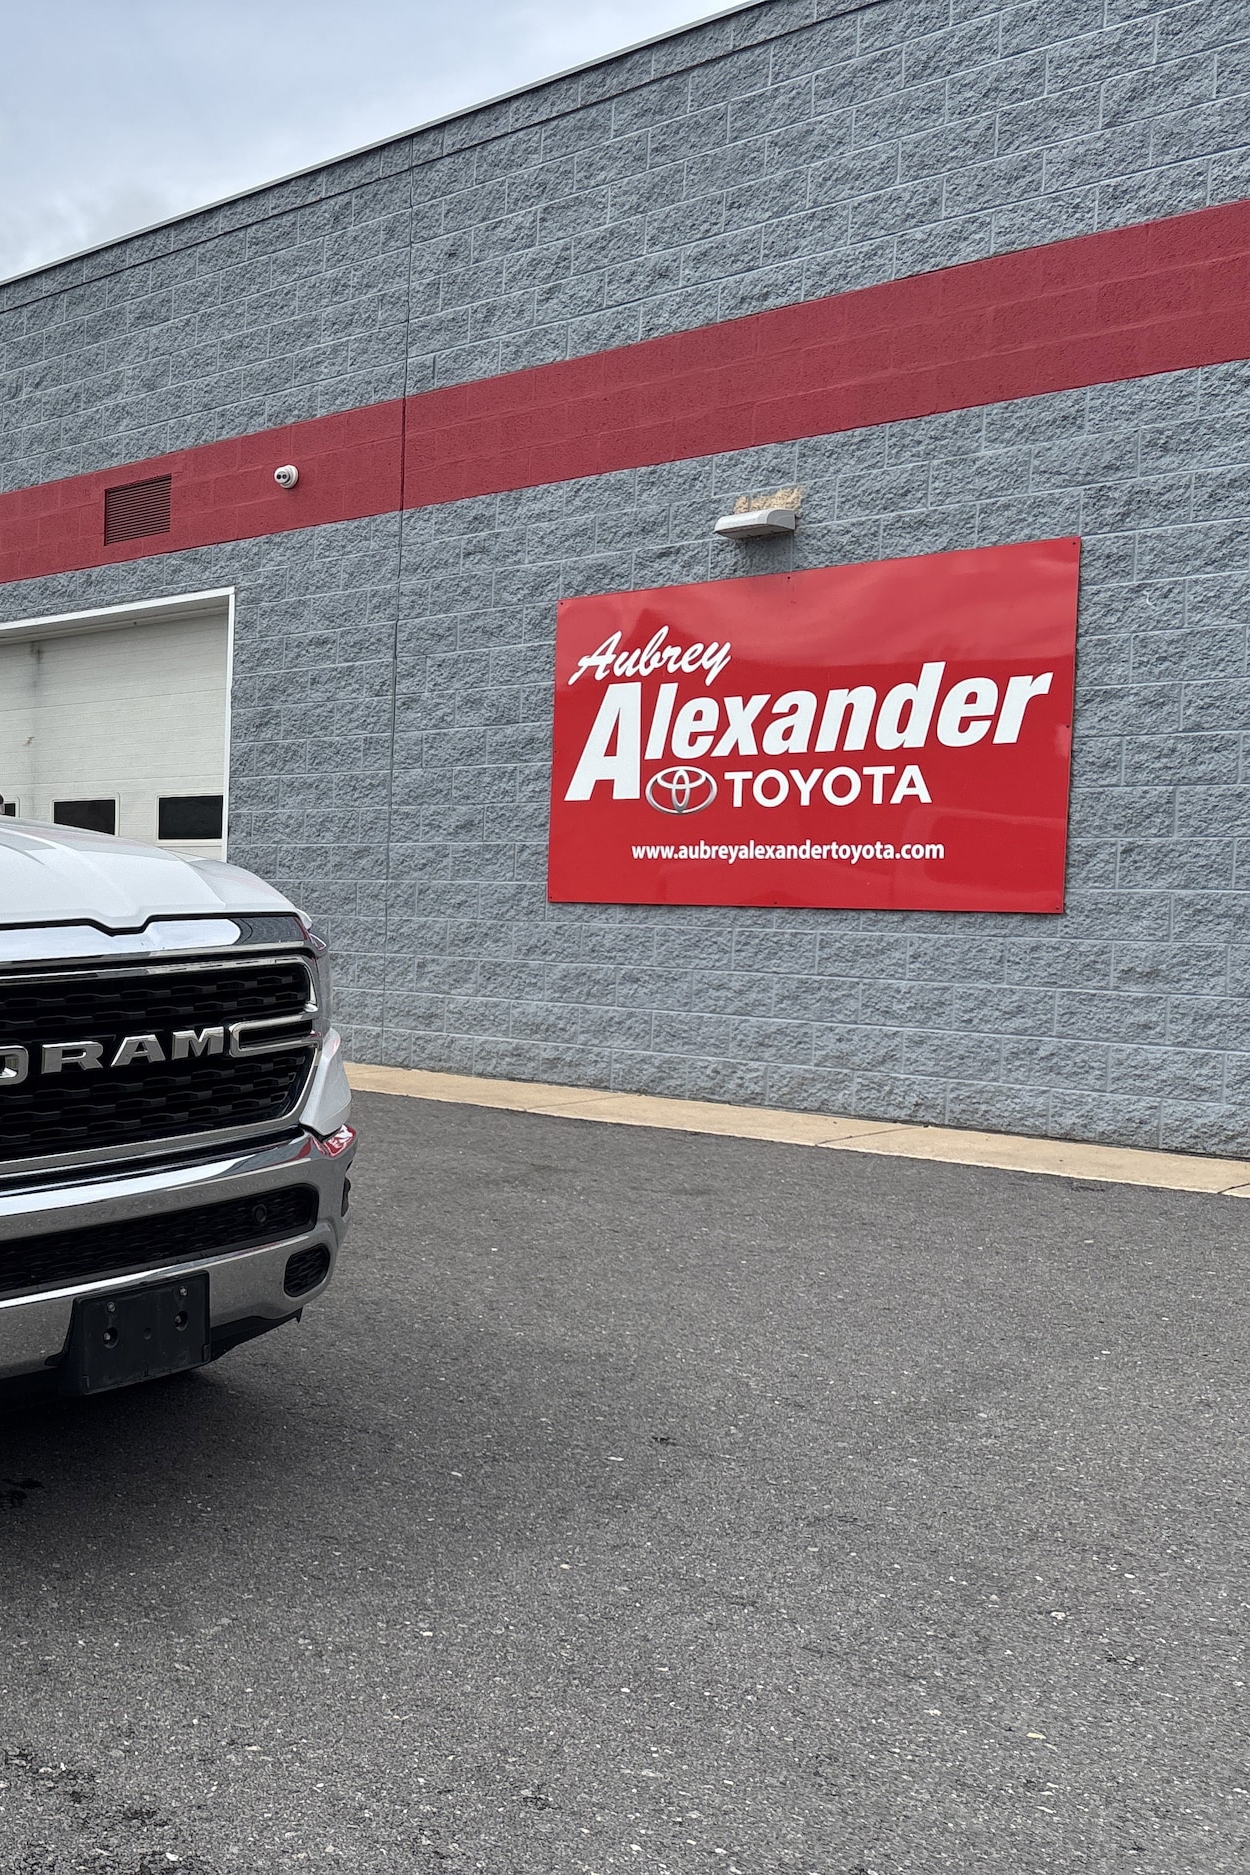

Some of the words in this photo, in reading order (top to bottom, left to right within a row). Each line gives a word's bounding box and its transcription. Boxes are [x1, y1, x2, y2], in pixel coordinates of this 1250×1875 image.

[568, 626, 731, 686] Aubrey
[564, 661, 1054, 801] Alexander
[724, 764, 932, 807] TOYOTA
[631, 839, 945, 865] www.aubreyalexandertoyota.com
[41, 1026, 225, 1074] RAM
